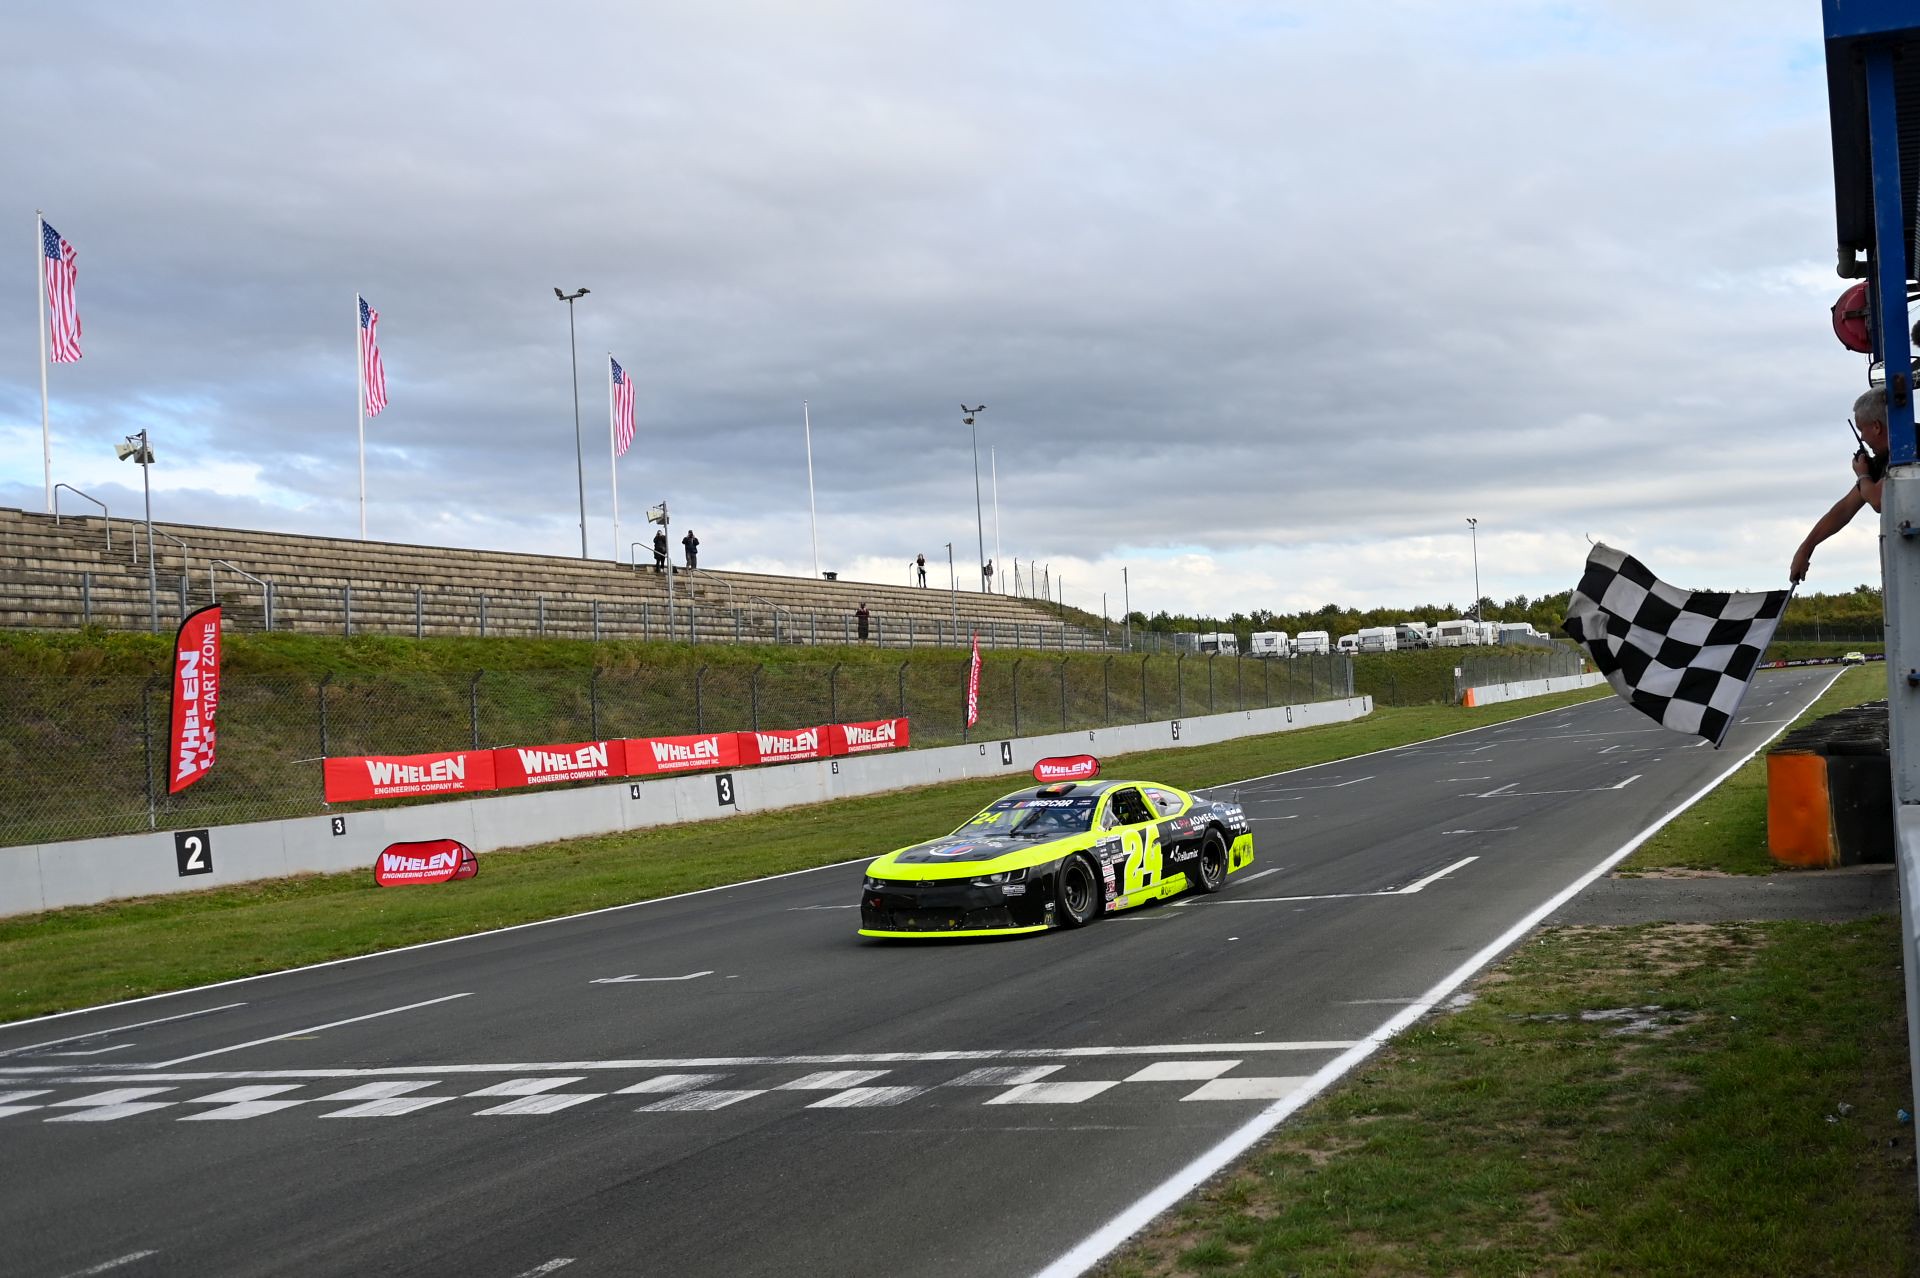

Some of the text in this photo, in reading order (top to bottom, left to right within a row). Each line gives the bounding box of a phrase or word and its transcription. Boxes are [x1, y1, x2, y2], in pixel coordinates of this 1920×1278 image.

[202, 622, 218, 722] START ZONE
[176, 651, 200, 781] WHELEN
[755, 728, 818, 754] WHELEN
[843, 720, 896, 745] WHELEN
[517, 742, 608, 775] WHELEN
[650, 737, 719, 762] WHELEN
[760, 753, 790, 763] ENGINEERING
[790, 752, 810, 761] COMPANY
[1003, 744, 1010, 762] 4
[365, 754, 465, 785] WHELEN
[658, 760, 689, 770] ENGINEERING
[689, 758, 711, 768] COMPANY
[1039, 760, 1092, 774] WHELEN
[527, 768, 608, 785] ENGINEERING COMPANY INC.
[374, 782, 464, 795] ENGINEERING COMPANY INC.
[632, 786, 639, 798] 4
[720, 778, 731, 801] 3
[335, 819, 343, 835] 3
[972, 812, 1003, 825] 24
[183, 835, 205, 870] 2
[381, 848, 459, 872] WHELEN
[1121, 823, 1163, 895] 24
[381, 869, 424, 880] ENGINEERING
[424, 867, 454, 878] COMPANY
